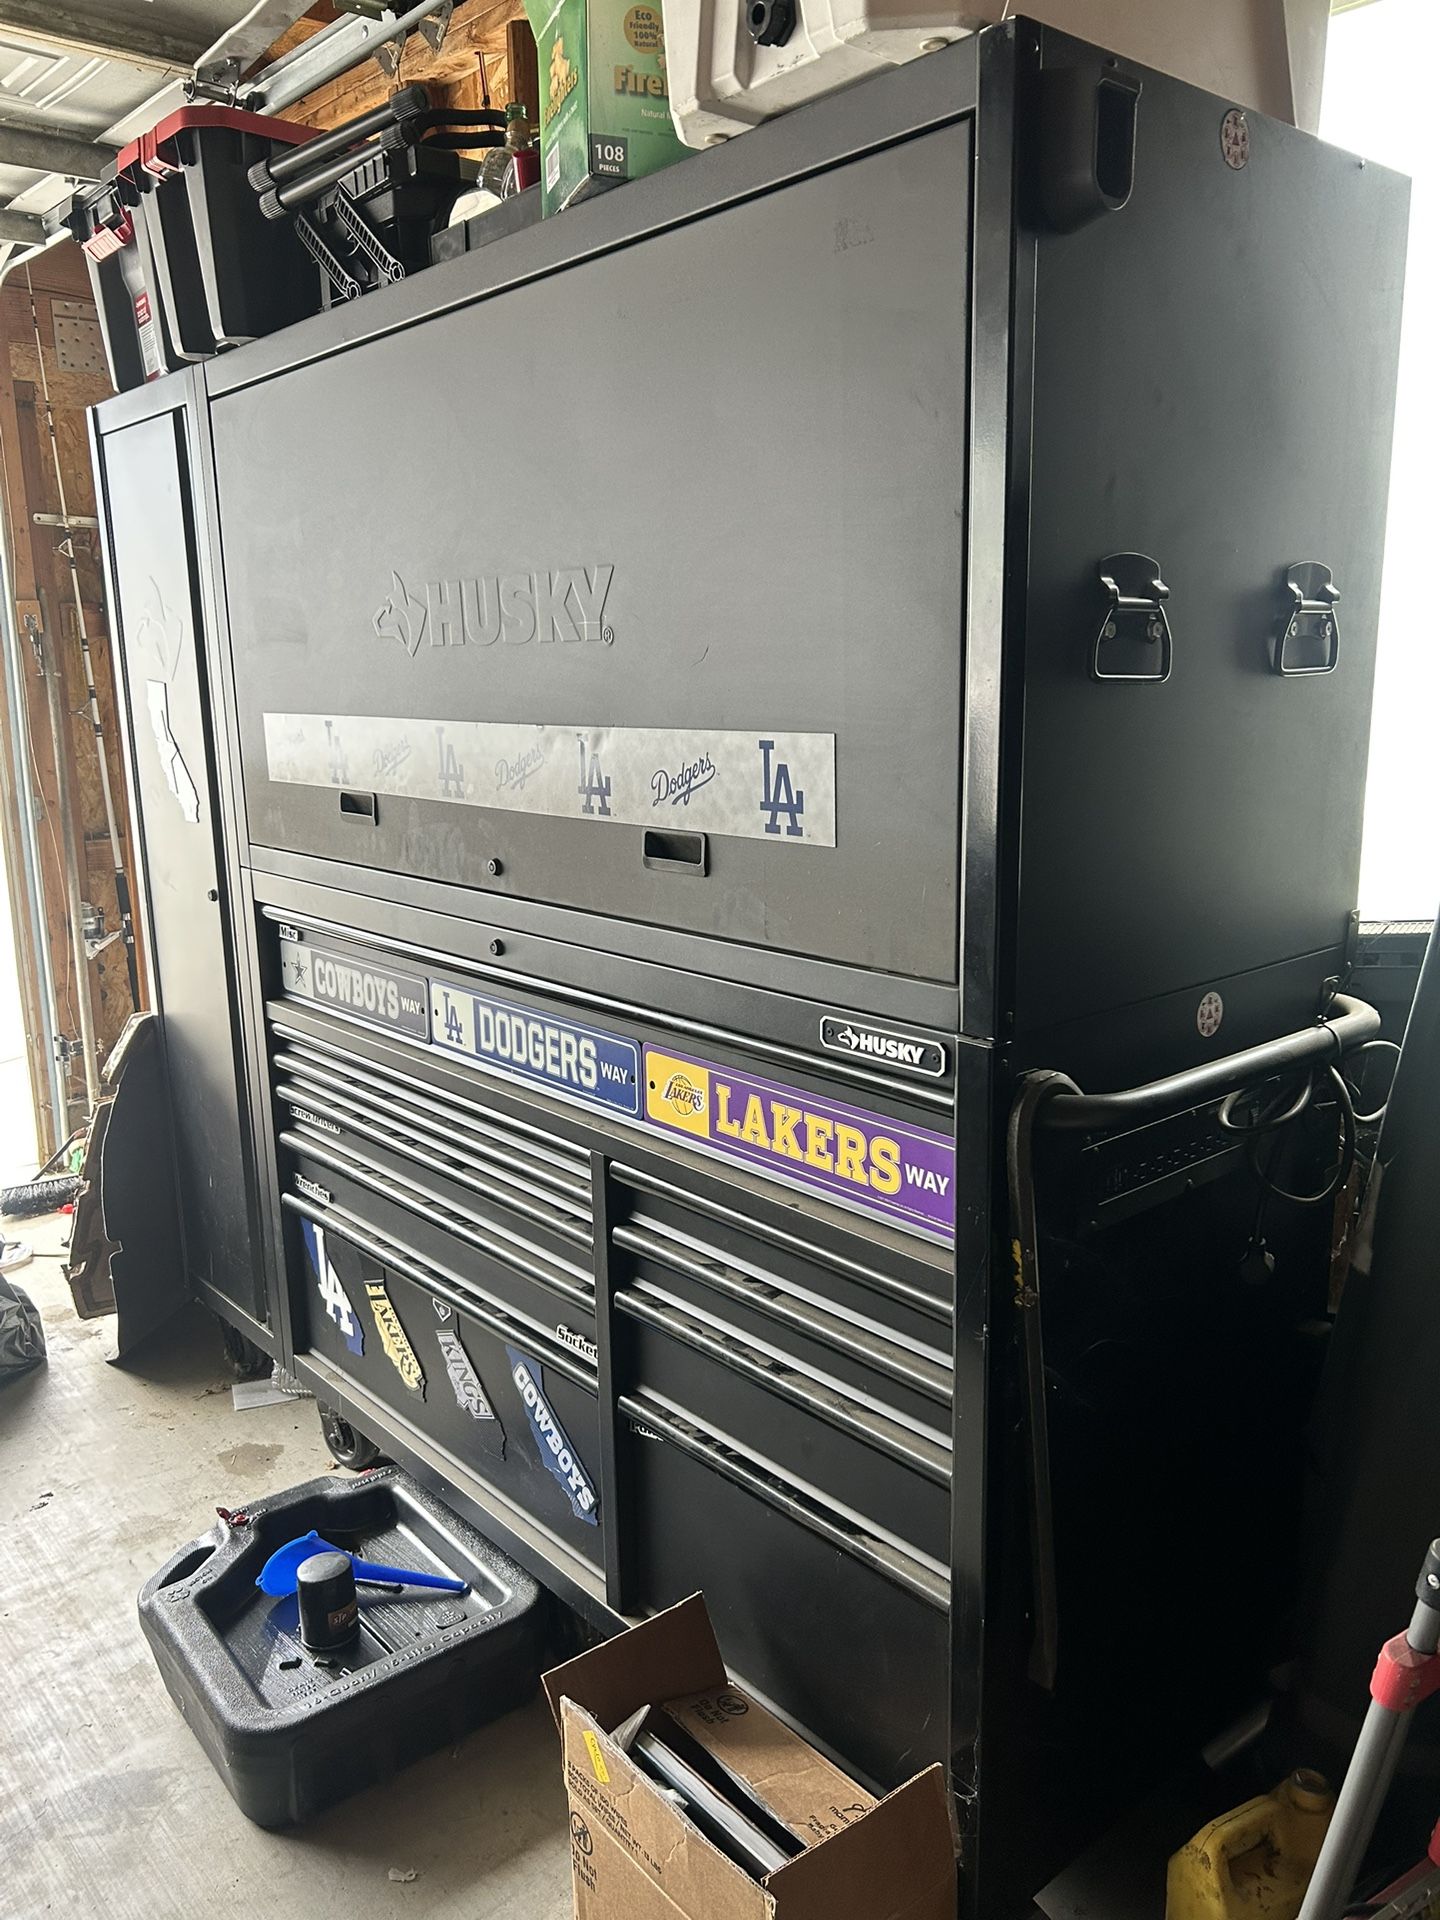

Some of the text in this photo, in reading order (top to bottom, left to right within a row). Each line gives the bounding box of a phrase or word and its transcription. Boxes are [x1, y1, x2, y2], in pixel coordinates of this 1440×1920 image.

[629, 22, 659, 32] Friendly
[635, 10, 652, 21] Eco
[634, 31, 657, 40] 100%
[634, 40, 658, 48] Natural
[641, 108, 665, 118] Natural
[595, 144, 624, 162] 108
[599, 163, 620, 173] PIECES
[426, 564, 614, 646] HUSKY
[495, 744, 544, 791] Dodgers
[577, 733, 611, 816] LA
[651, 752, 716, 806] Dodgers
[759, 740, 804, 836] LA
[280, 926, 296, 940] Misc
[314, 958, 421, 1020] COWBOYS WAY
[443, 991, 463, 1044] LA
[479, 1005, 629, 1090] DODGERS WAY
[859, 1033, 925, 1065] HUSKY
[664, 1081, 704, 1111] LAKERS
[715, 1083, 950, 1196] LAKERS WAY
[313, 1223, 354, 1337] LA
[441, 1340, 489, 1415] KINGS
[514, 1365, 596, 1511] COWBOYS
[440, 1609, 504, 1644] Capacity
[711, 1709, 731, 1724] Not
[578, 1779, 597, 1804] TOTAL
[572, 1861, 596, 1893] Flush
[583, 1856, 598, 1881] Not
